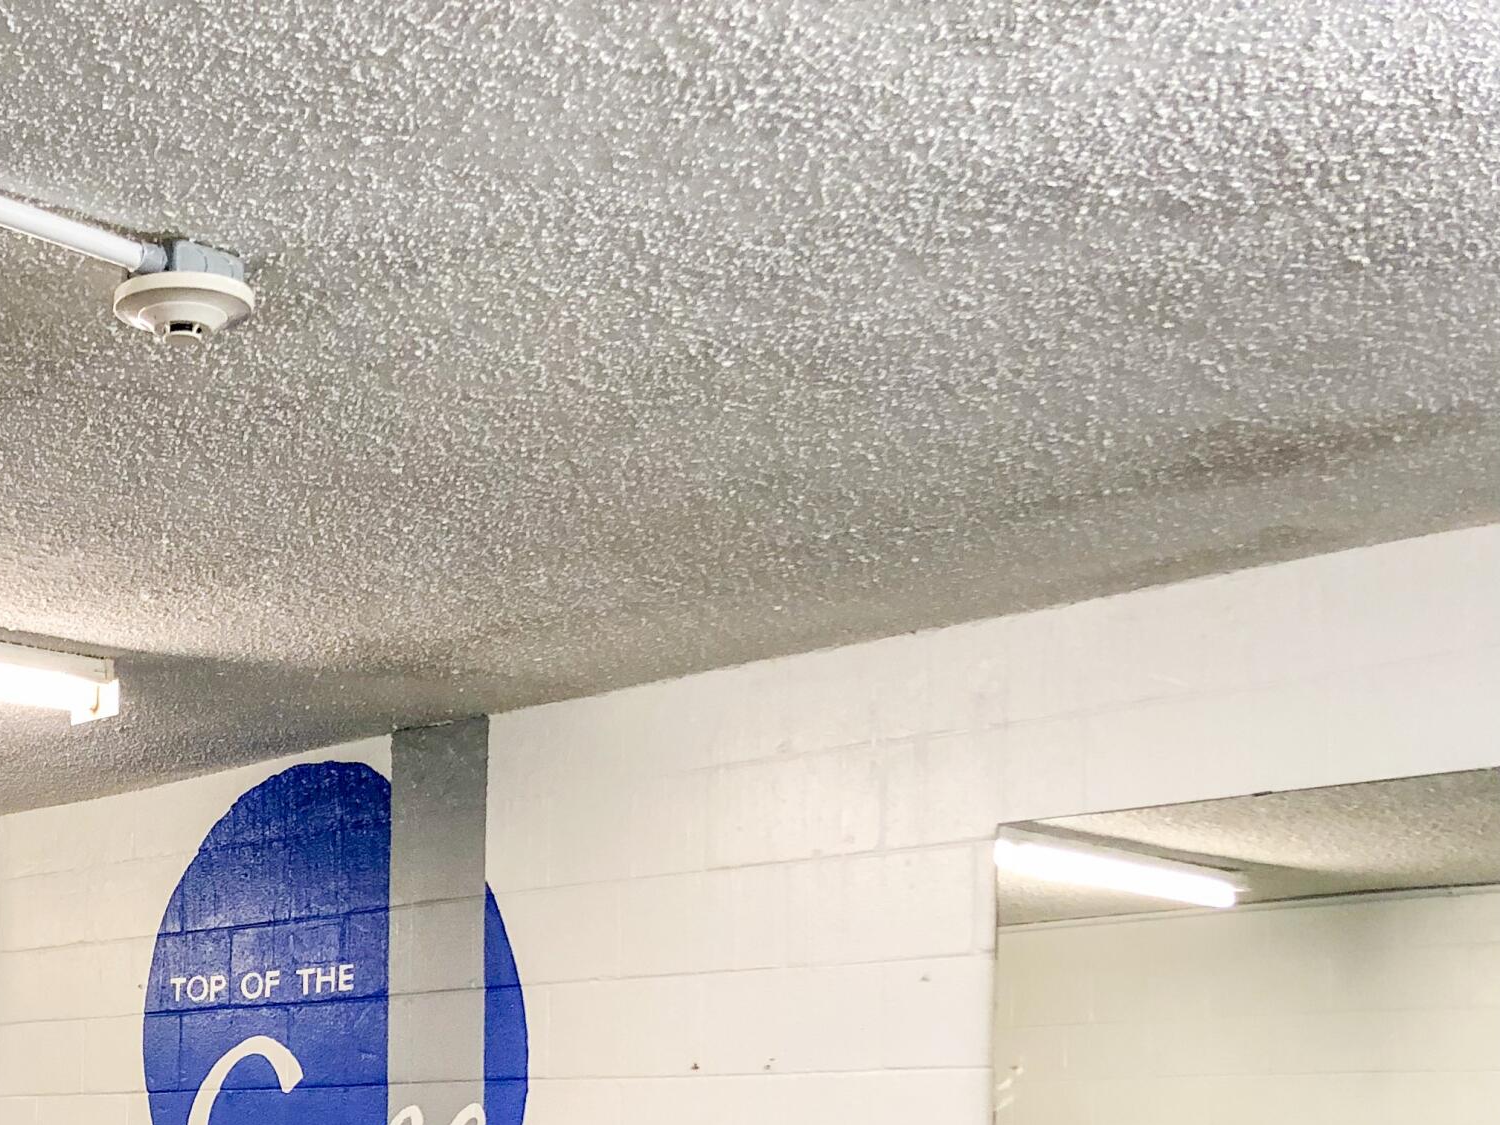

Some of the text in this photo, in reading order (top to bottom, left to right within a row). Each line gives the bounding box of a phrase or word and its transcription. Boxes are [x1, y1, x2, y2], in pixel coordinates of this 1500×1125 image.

[170, 963, 355, 1003] TOP OF THE
